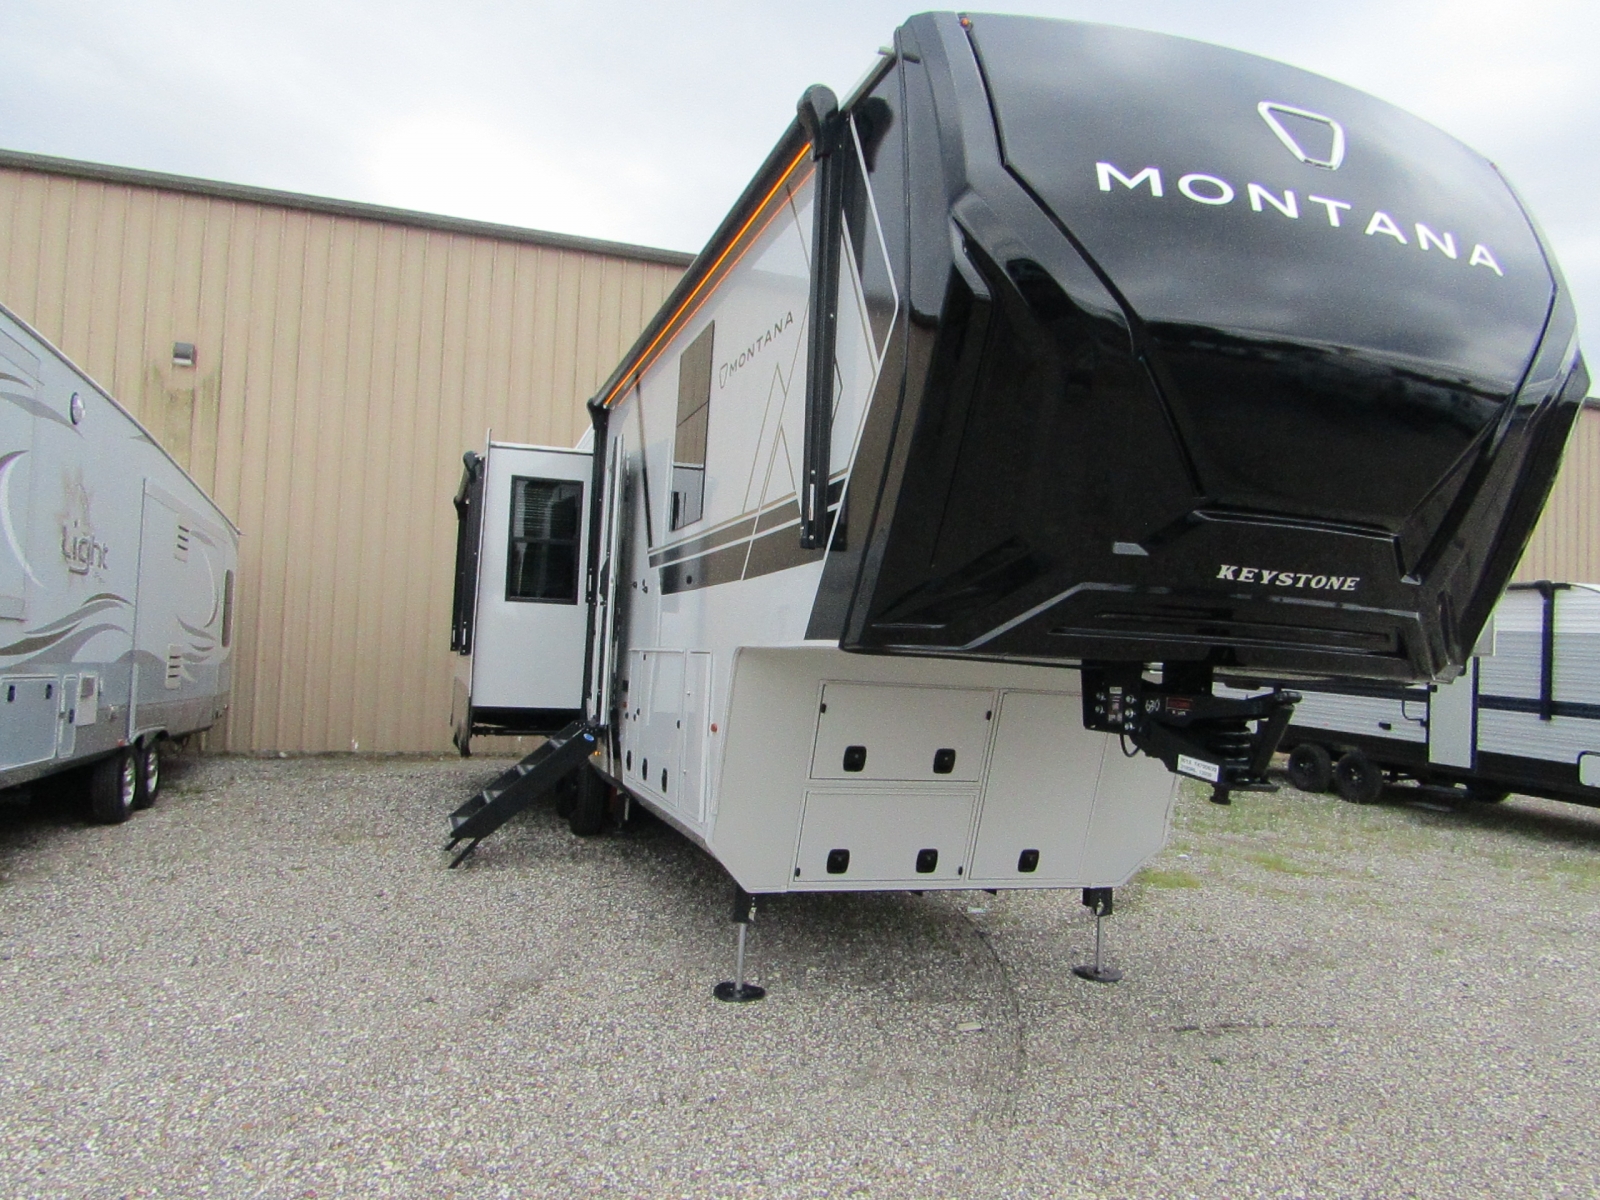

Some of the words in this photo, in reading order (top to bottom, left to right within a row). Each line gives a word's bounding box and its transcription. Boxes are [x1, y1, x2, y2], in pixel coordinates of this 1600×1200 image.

[1095, 161, 1504, 277] MONTANA
[729, 311, 794, 377] MONTANA
[61, 519, 109, 576] Light
[1216, 564, 1360, 591] KEYSTONE
